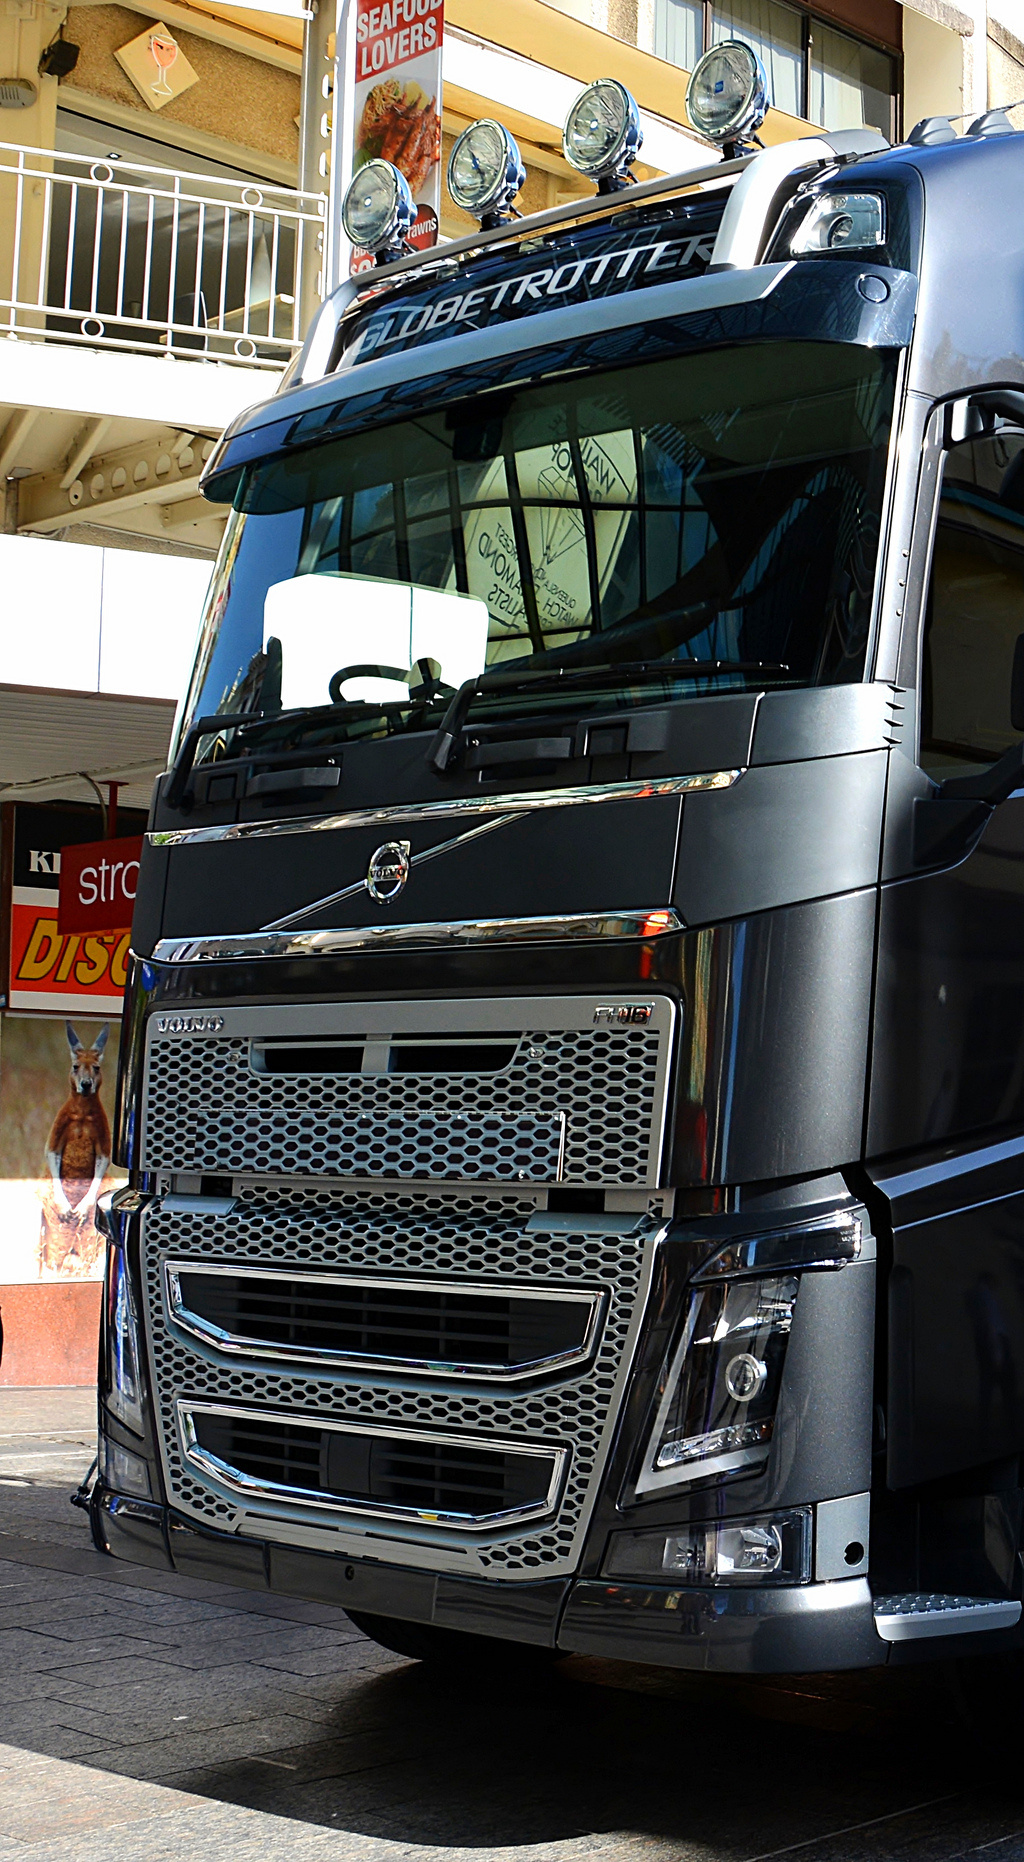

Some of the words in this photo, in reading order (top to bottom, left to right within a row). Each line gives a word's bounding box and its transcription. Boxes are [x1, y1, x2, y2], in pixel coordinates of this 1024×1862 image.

[361, 16, 437, 76] LOVERS
[407, 217, 437, 240] rawns
[353, 231, 716, 357] GLOBETROTTER
[370, 868, 406, 878] VOLVO
[156, 1015, 224, 1033] VOLVO
